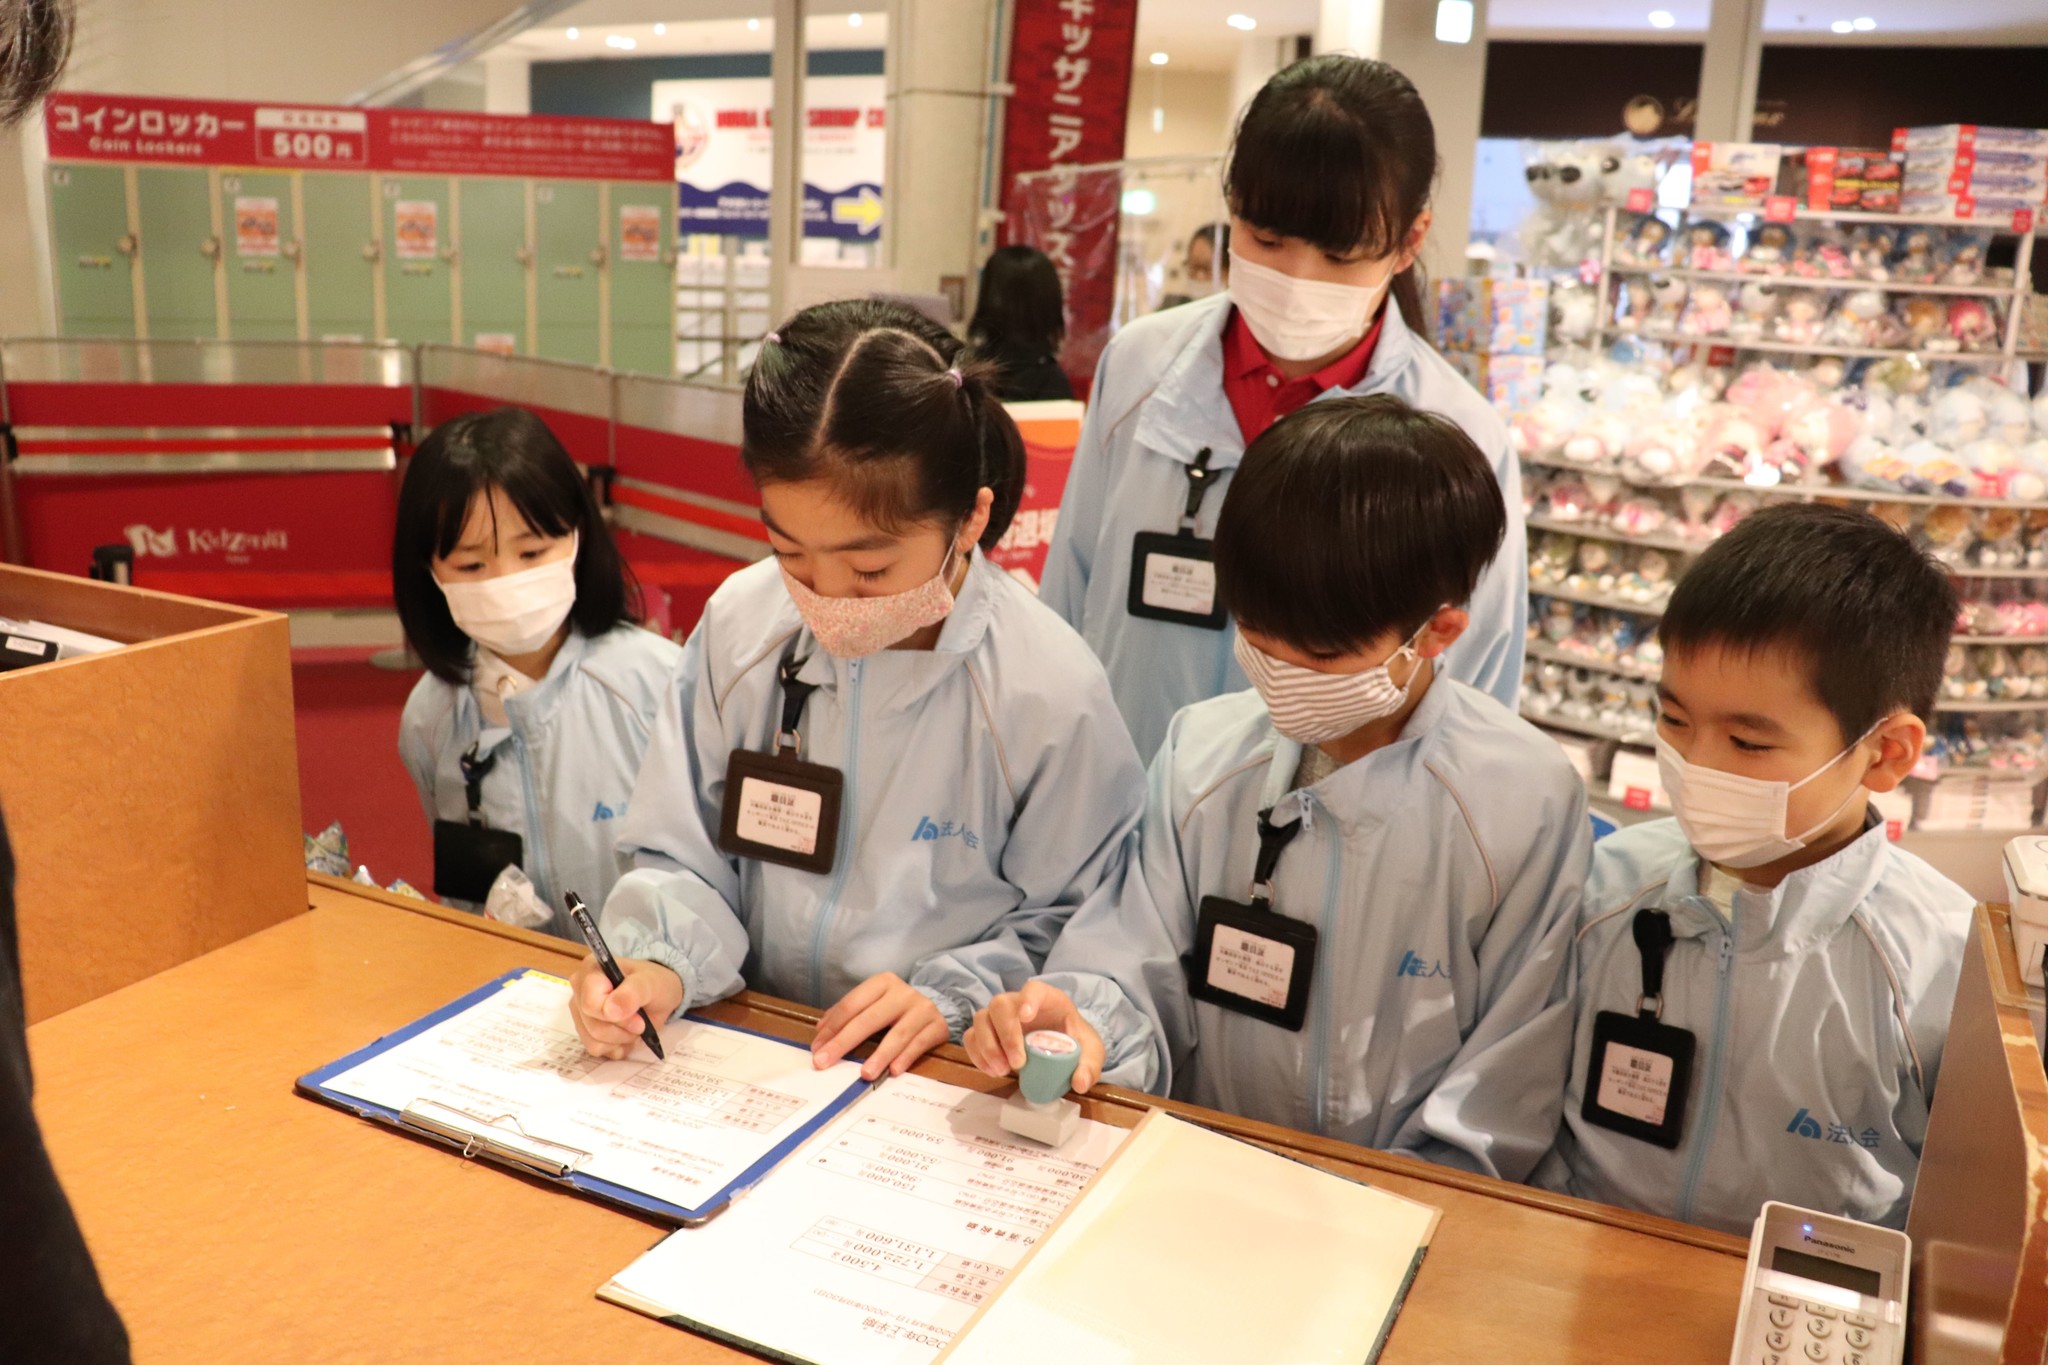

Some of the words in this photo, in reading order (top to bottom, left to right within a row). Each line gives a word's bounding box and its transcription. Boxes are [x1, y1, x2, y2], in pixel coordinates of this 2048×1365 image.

[54, 104, 245, 138] コインロッカー
[940, 820, 980, 849] 法人会
[1410, 957, 1452, 978] 法人
[1826, 1121, 1882, 1149] 法人会
[1804, 1234, 1856, 1254] Panasonic
